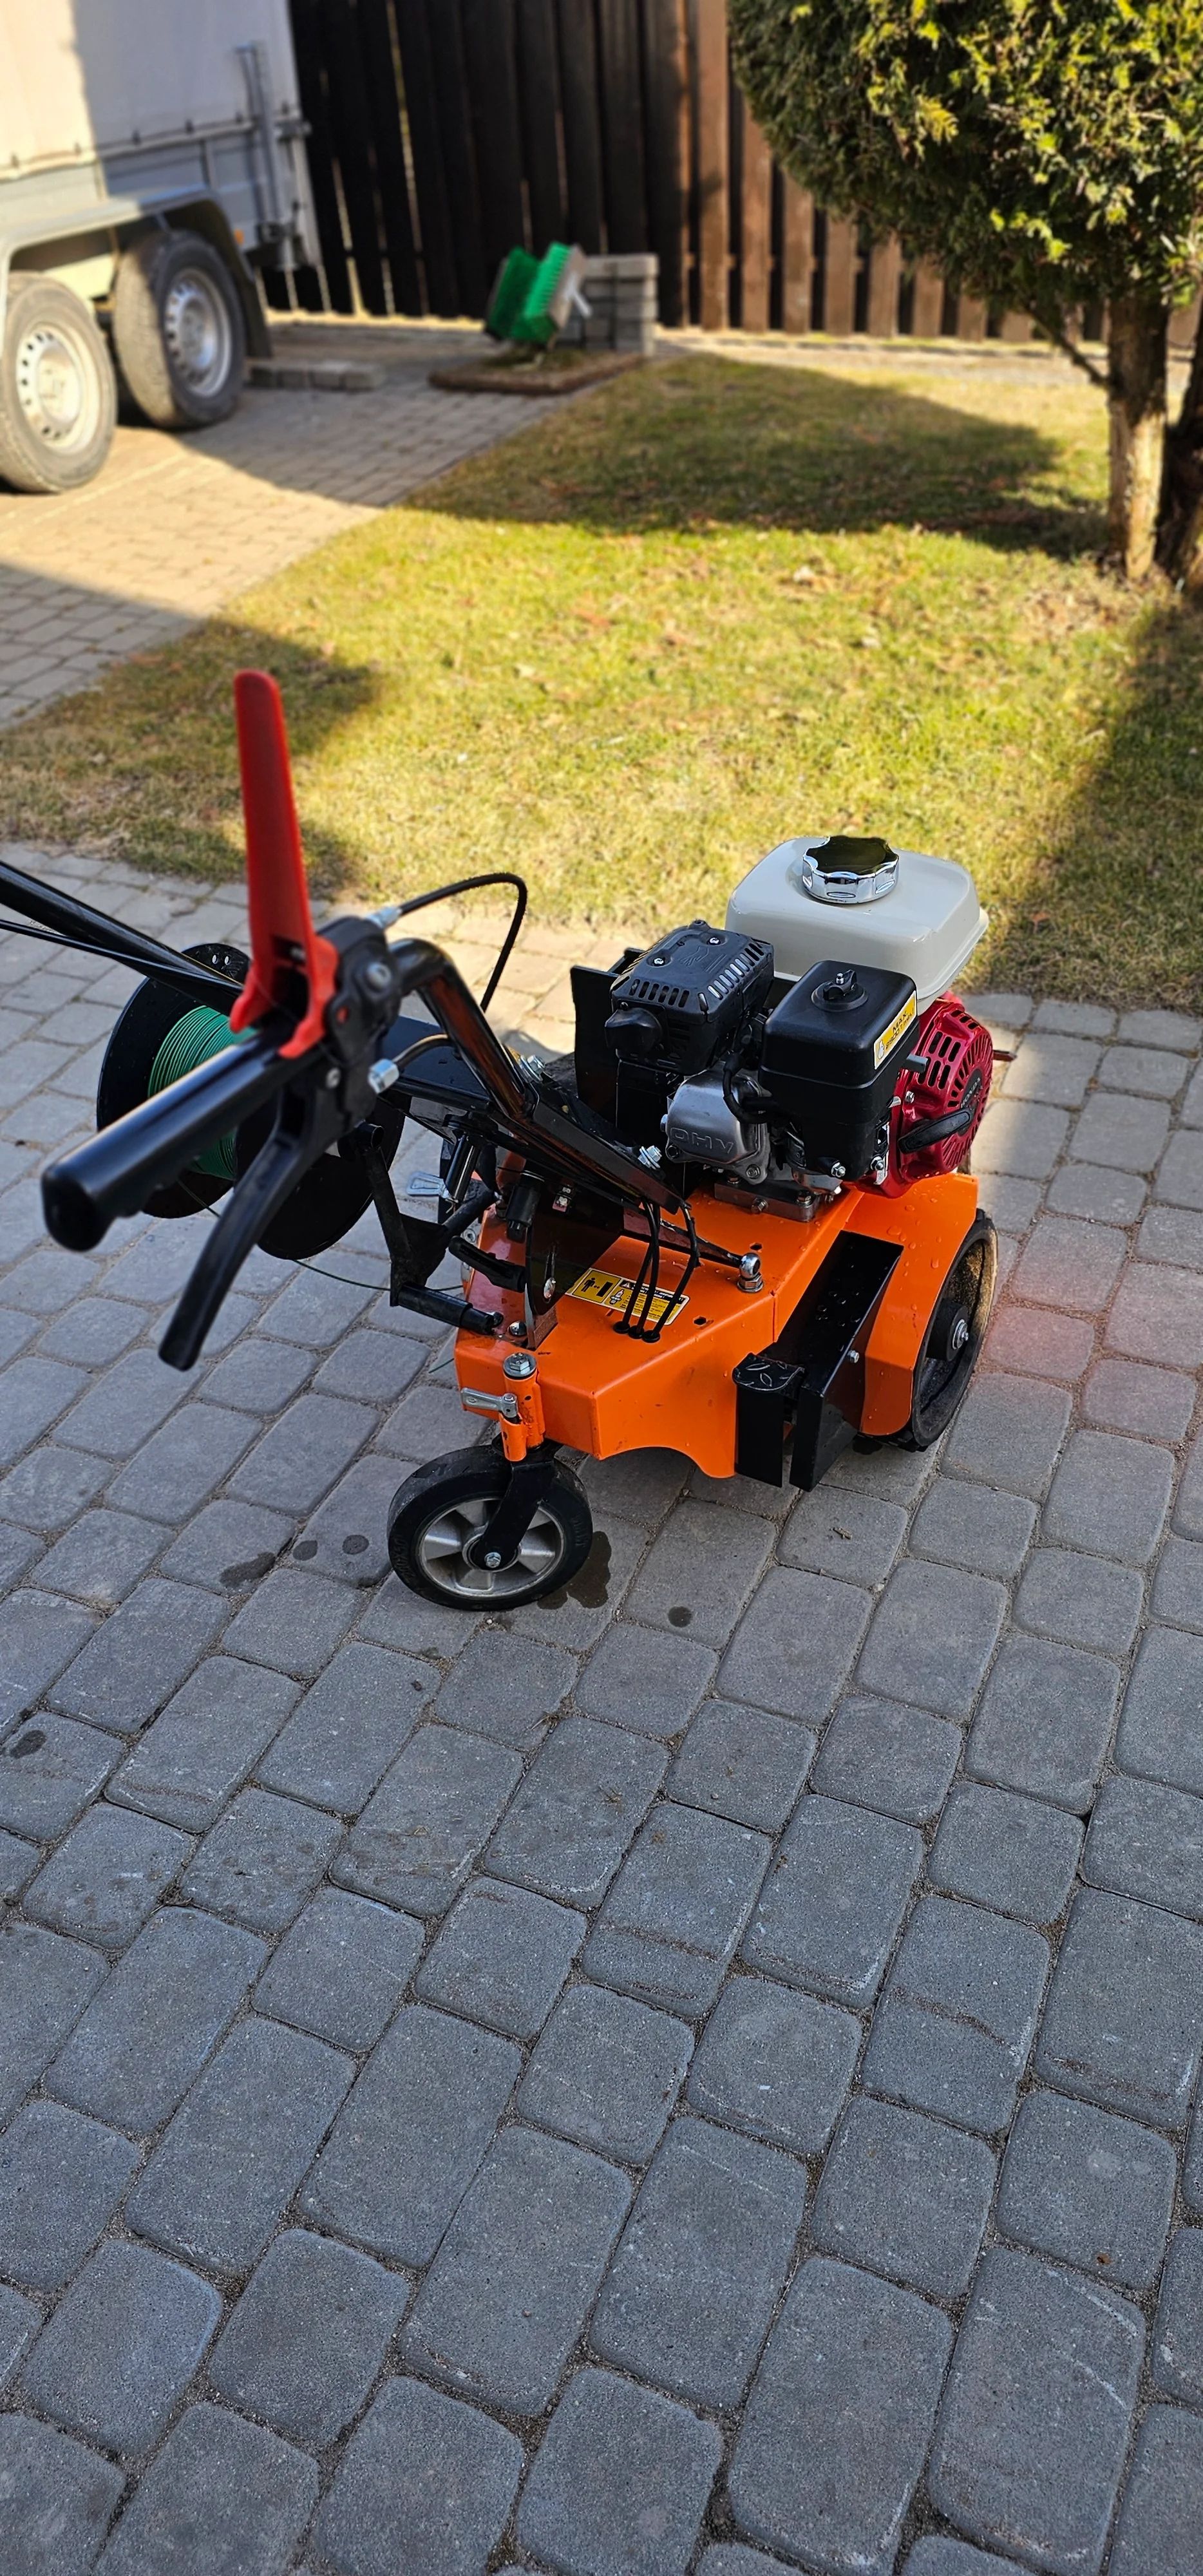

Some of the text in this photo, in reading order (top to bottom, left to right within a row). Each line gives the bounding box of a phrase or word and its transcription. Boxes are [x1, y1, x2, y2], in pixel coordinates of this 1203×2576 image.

[893, 1010, 907, 1034] MAX
[960, 1077, 981, 1108] HONDA
[670, 1127, 734, 1154] OHV
